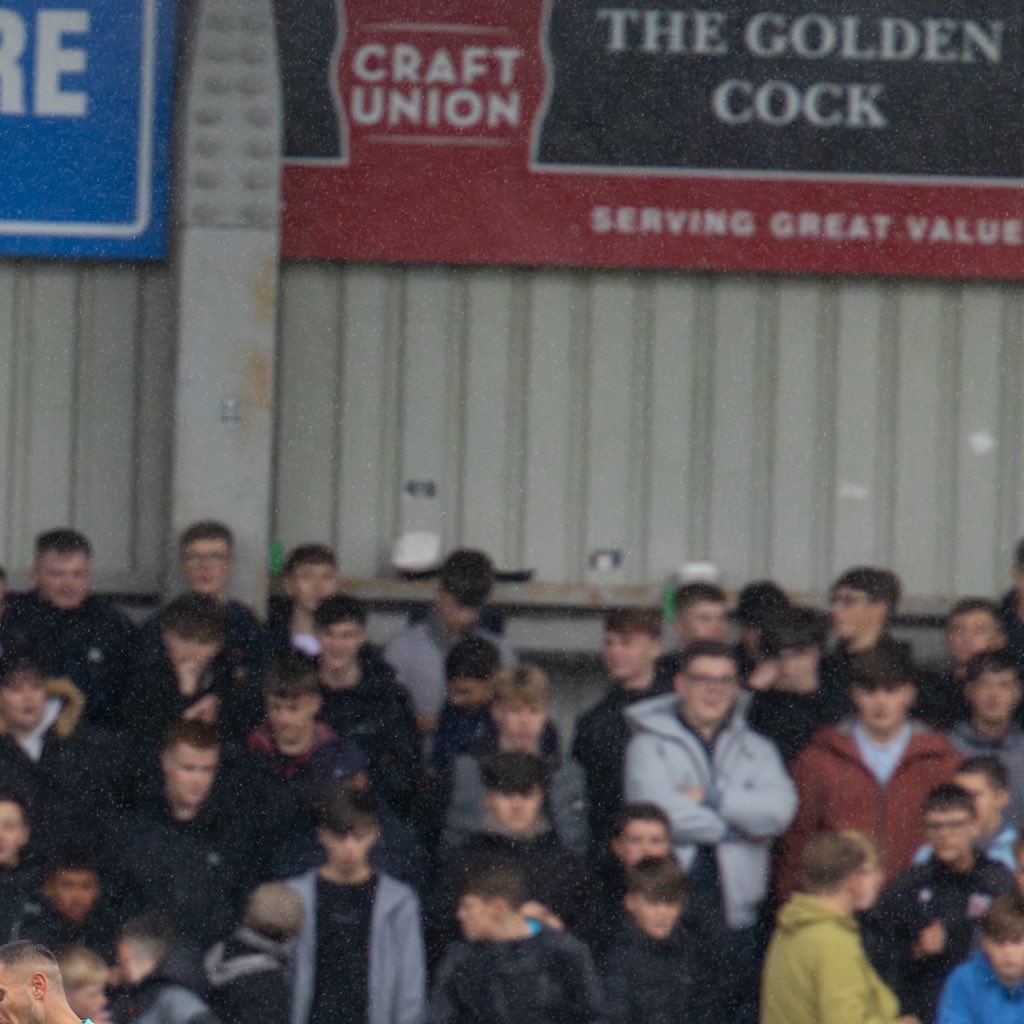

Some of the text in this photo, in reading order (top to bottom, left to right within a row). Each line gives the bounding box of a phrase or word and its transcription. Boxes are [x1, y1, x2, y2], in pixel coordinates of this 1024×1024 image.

[596, 7, 1005, 64] THE GOLDEN
[353, 43, 522, 86] CRAFT
[352, 85, 521, 128] UNION
[711, 78, 889, 129] COCK
[590, 205, 1024, 246] SERVING GREAT VALUE
